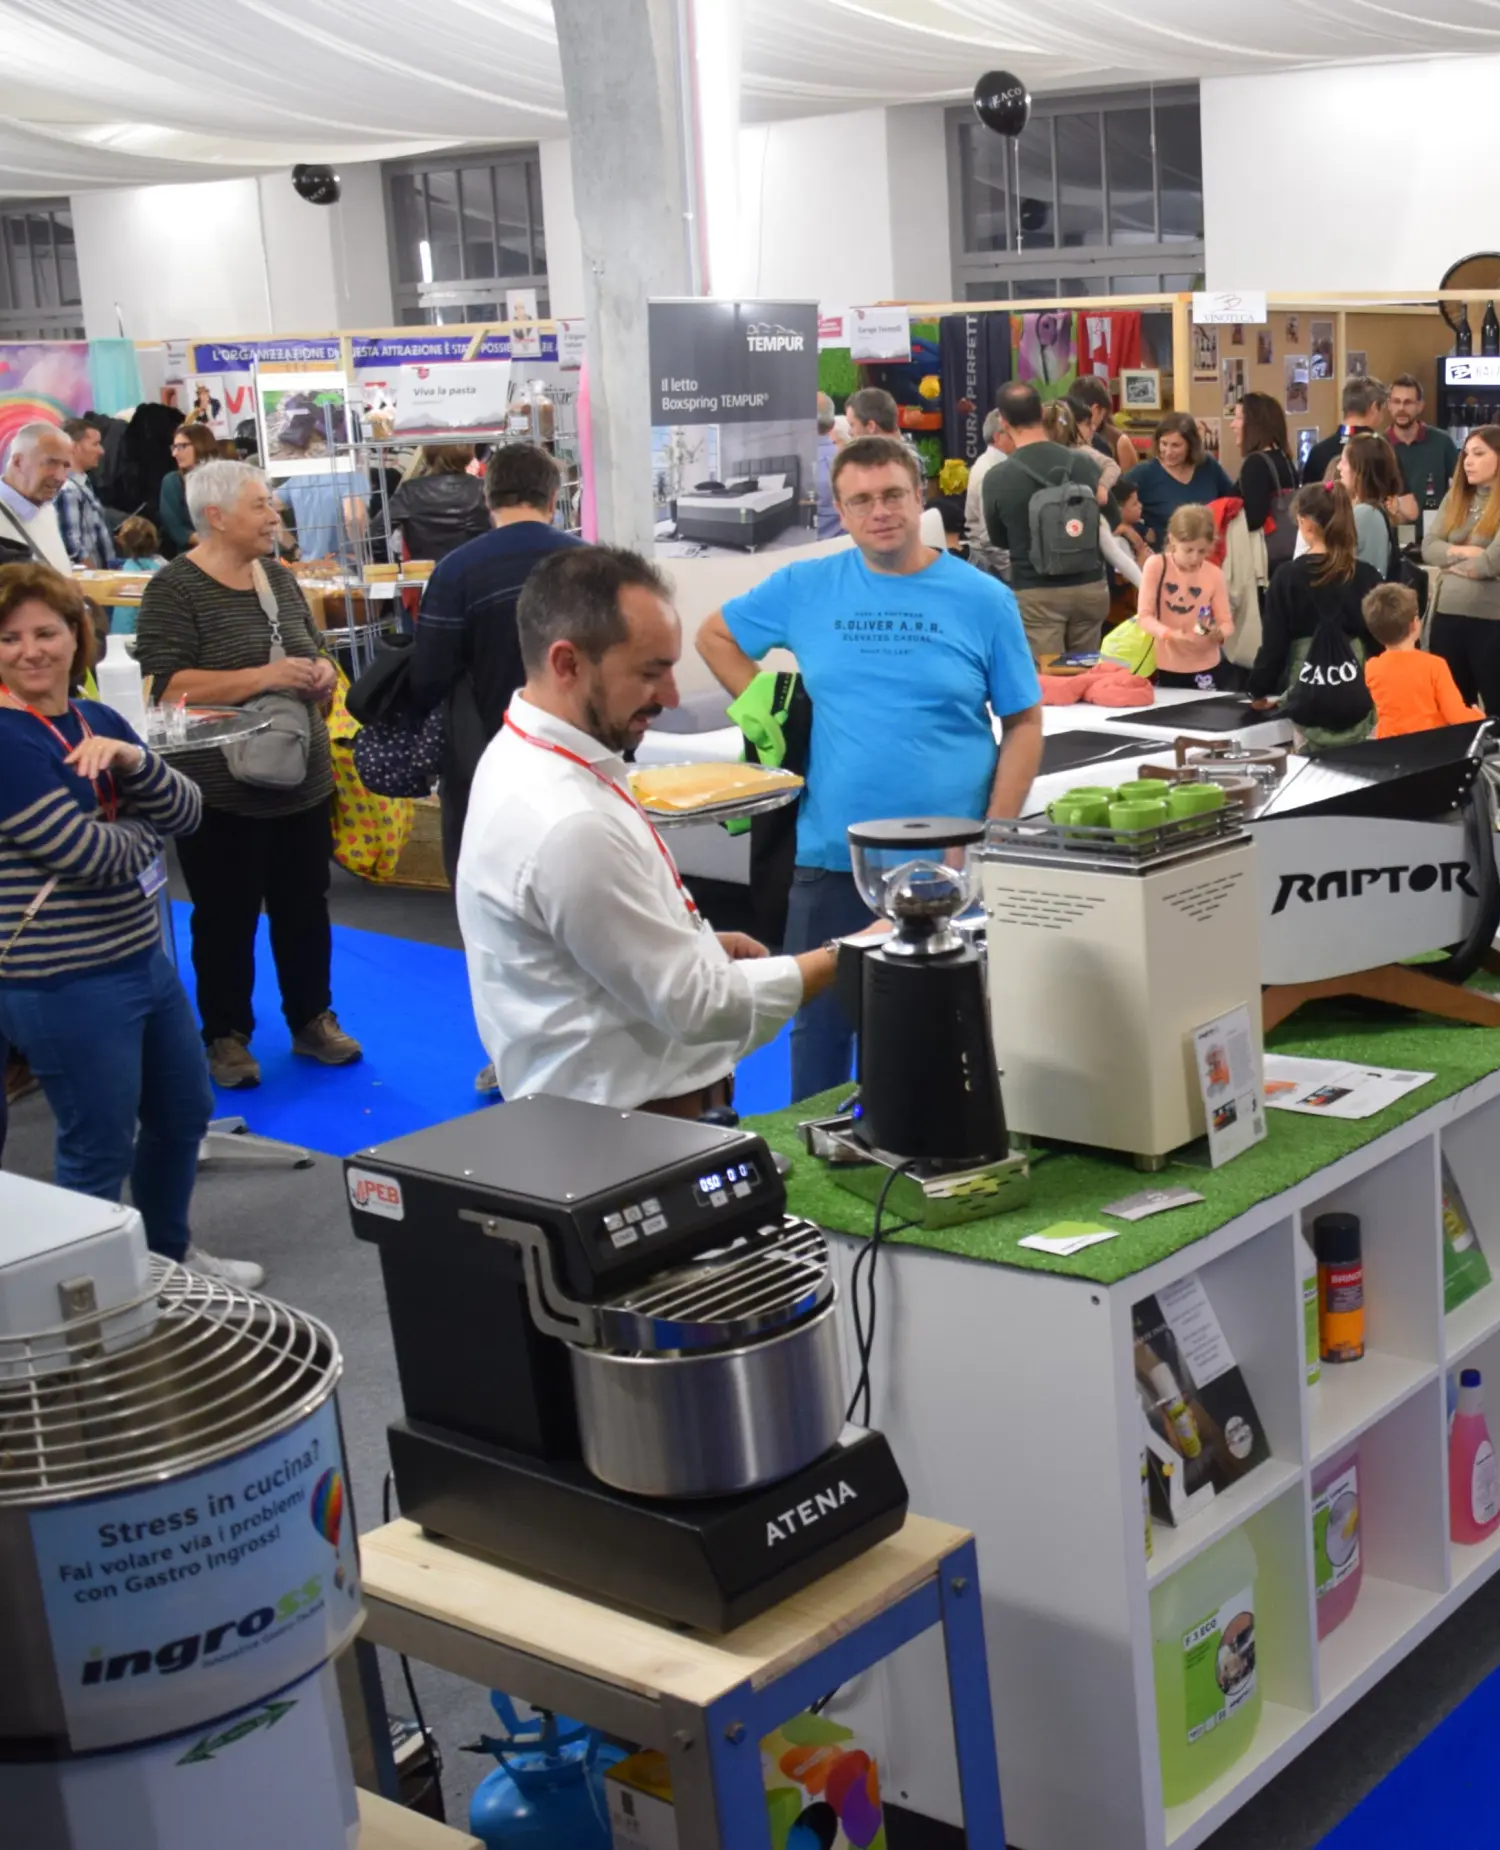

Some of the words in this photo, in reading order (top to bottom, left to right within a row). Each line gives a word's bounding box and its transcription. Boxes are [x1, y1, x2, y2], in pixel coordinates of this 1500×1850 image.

[1203, 314, 1255, 322] VINOTECA
[381, 343, 442, 357] ATTRAZIONE
[747, 336, 804, 352] TEMPUR
[413, 387, 435, 397] Viva
[437, 386, 447, 396] la
[449, 386, 476, 397] pasta
[661, 378, 669, 392] Il
[671, 377, 698, 392] letto
[661, 394, 718, 412] Boxspring
[834, 620, 894, 631] S.OLIVER
[843, 633, 891, 642] ELEVATED
[893, 634, 932, 643] CASUAL
[1269, 861, 1480, 916] RAPTOR
[98, 1506, 199, 1549] Stress
[207, 1493, 236, 1518] in
[243, 1438, 321, 1503] cucina?
[766, 1480, 858, 1547] ATENA
[60, 1561, 93, 1583] Fai
[101, 1546, 173, 1577] volare
[180, 1533, 213, 1555] via
[218, 1526, 225, 1543] i
[230, 1487, 306, 1540] problemi
[73, 1582, 119, 1604] con
[125, 1561, 202, 1594] Gastro
[207, 1525, 282, 1570] Ingross!
[81, 1573, 324, 1687] ingross
[1200, 1618, 1217, 1638] ECO
